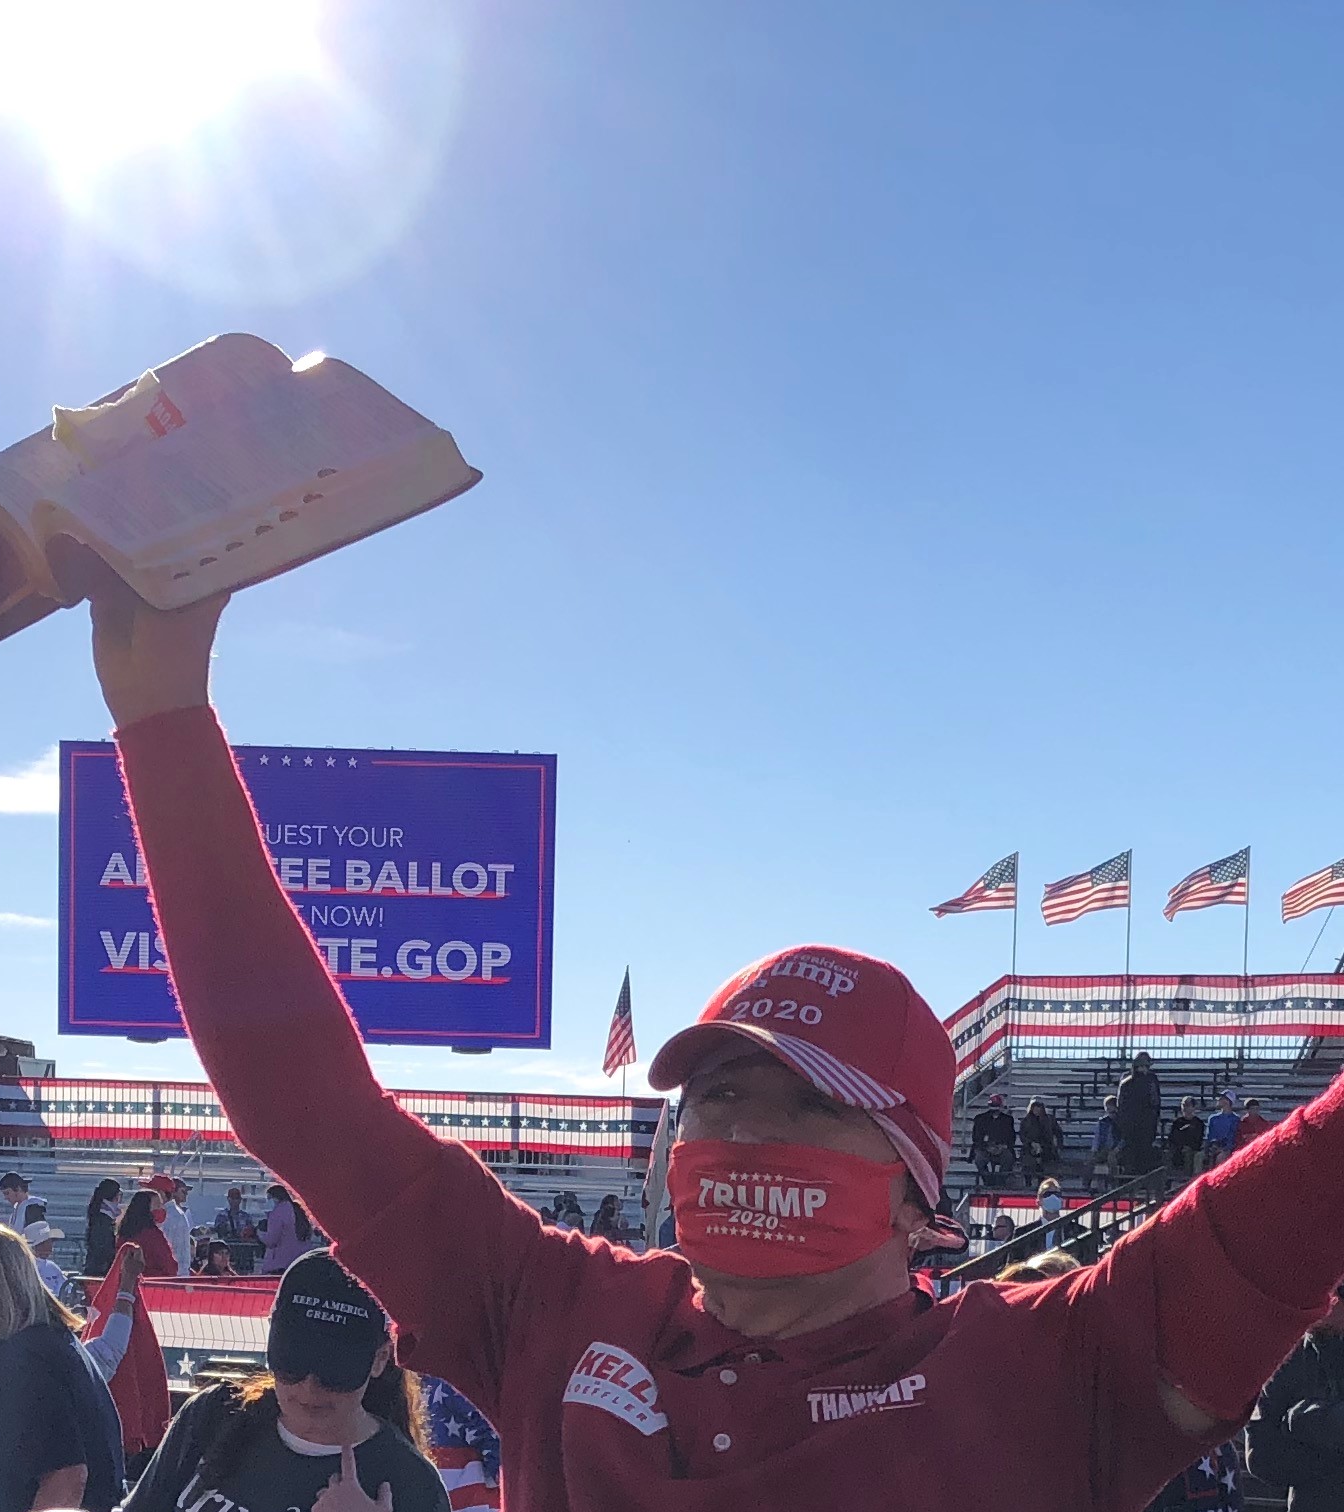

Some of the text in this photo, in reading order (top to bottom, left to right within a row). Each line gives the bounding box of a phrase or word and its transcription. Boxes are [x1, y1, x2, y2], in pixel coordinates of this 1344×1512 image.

[265, 824, 404, 848] UEST YOUR
[346, 859, 515, 897] BALLOT
[311, 905, 384, 928] NOW!
[317, 938, 512, 981] TE.GOP
[729, 998, 823, 1025] 2020
[697, 1177, 827, 1218] TRUMP
[728, 1209, 779, 1230] 2020
[292, 1294, 369, 1319] KEEP AMERICA
[305, 1308, 347, 1325] GREAT!
[575, 1349, 655, 1411] KELL
